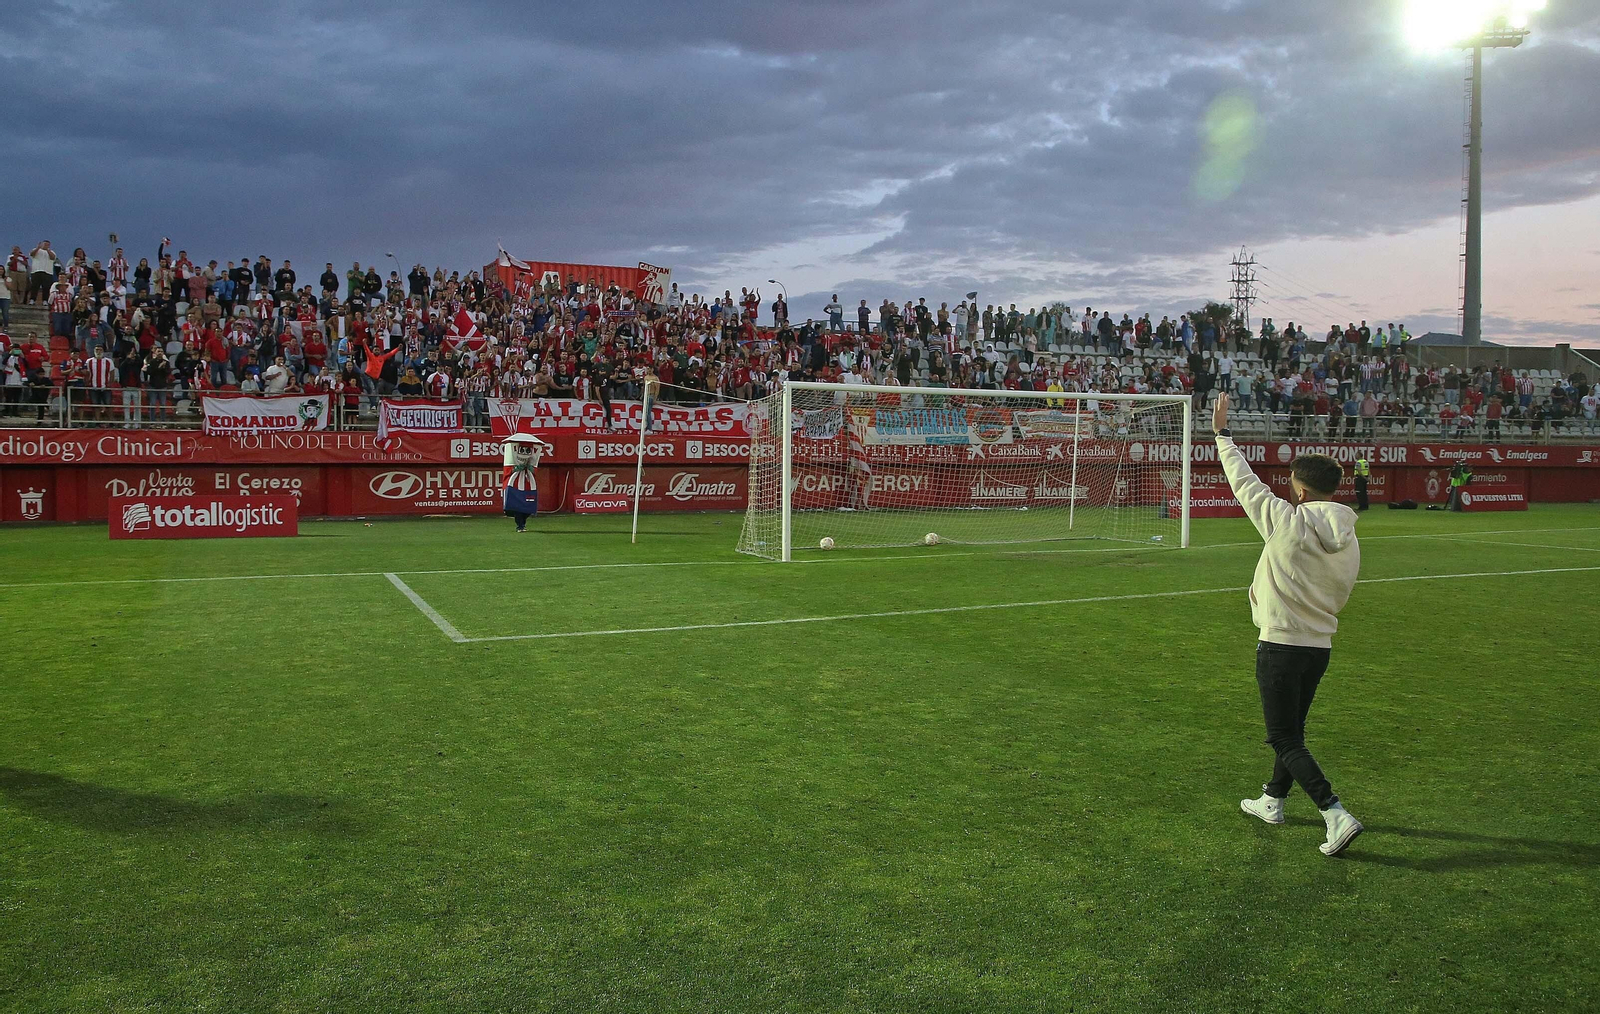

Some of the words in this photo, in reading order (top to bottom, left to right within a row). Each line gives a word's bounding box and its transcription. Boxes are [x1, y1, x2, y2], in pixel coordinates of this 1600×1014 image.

[208, 415, 298, 427] KOMANDO
[530, 402, 735, 431] ALGECIRAS
[97, 436, 182, 456] Clinical
[230, 434, 304, 449] MOLINO
[306, 434, 333, 449] DE
[472, 441, 554, 456] BESR
[598, 443, 674, 457] BESOCCER
[705, 443, 775, 457] BESOCCER
[988, 443, 1042, 457] CaixaBank
[1066, 443, 1118, 457] CaixaBank
[1379, 446, 1407, 463] SUR
[1439, 449, 1482, 460] Emalgesa
[1506, 450, 1549, 462] Emalgesa
[149, 469, 195, 487] Venta
[215, 473, 230, 489] El
[237, 472, 302, 489] Cerezo
[425, 471, 503, 488] HYUND
[425, 488, 504, 499] PERMOT
[153, 502, 284, 532] totallogistic
